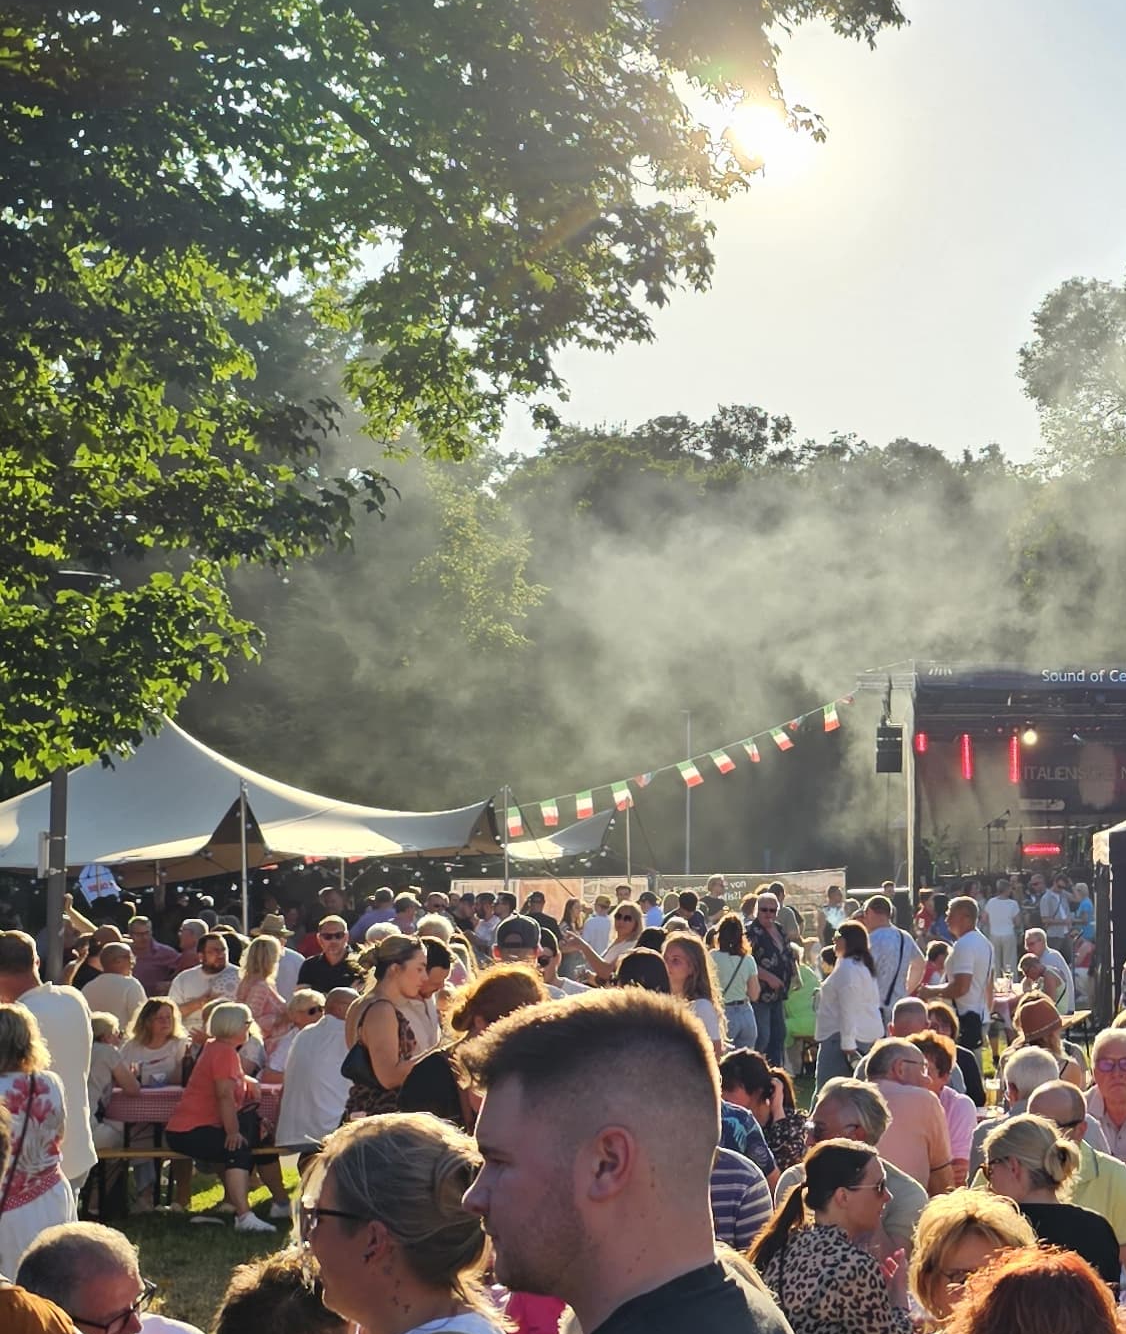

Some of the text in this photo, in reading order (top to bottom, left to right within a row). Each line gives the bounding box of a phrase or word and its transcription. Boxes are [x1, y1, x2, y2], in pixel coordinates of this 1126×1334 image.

[1042, 670, 1085, 682] Sound
[1090, 669, 1106, 682] of
[730, 880, 747, 889] von
